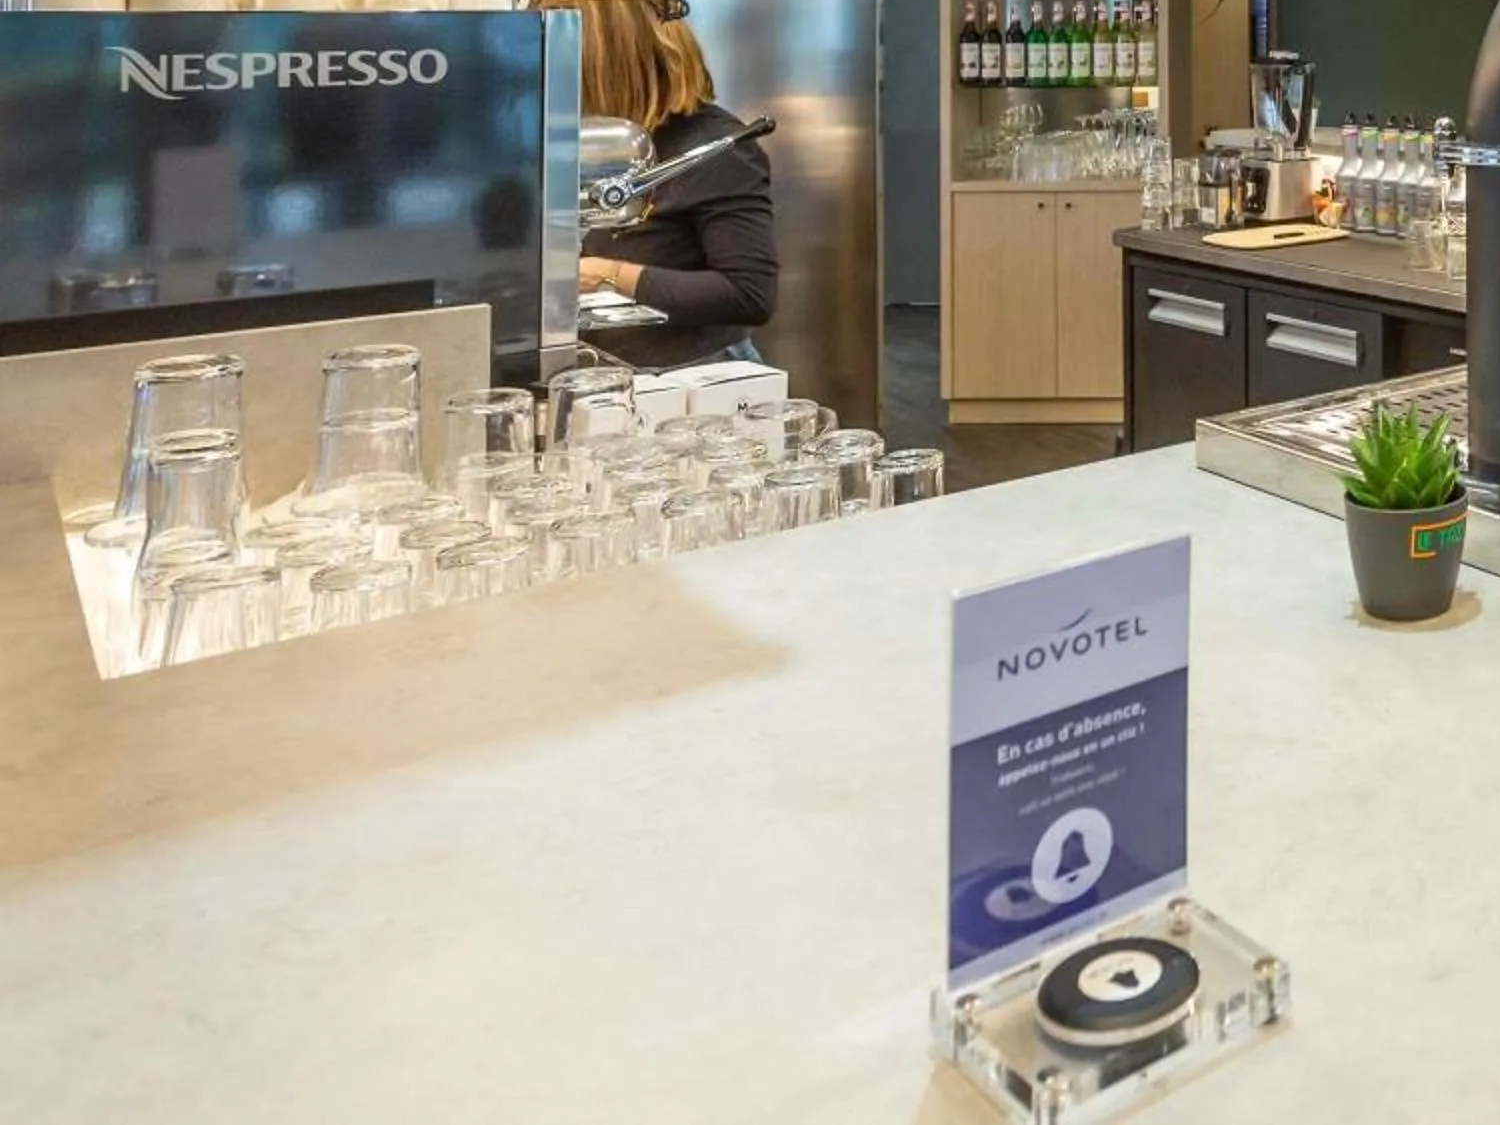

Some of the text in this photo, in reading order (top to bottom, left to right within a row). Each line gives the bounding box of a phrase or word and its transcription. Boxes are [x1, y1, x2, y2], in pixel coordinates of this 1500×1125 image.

[105, 46, 449, 100] NESPRESSO
[997, 615, 1148, 681] NOVOTEL
[997, 702, 1147, 766] En cas d'absence,
